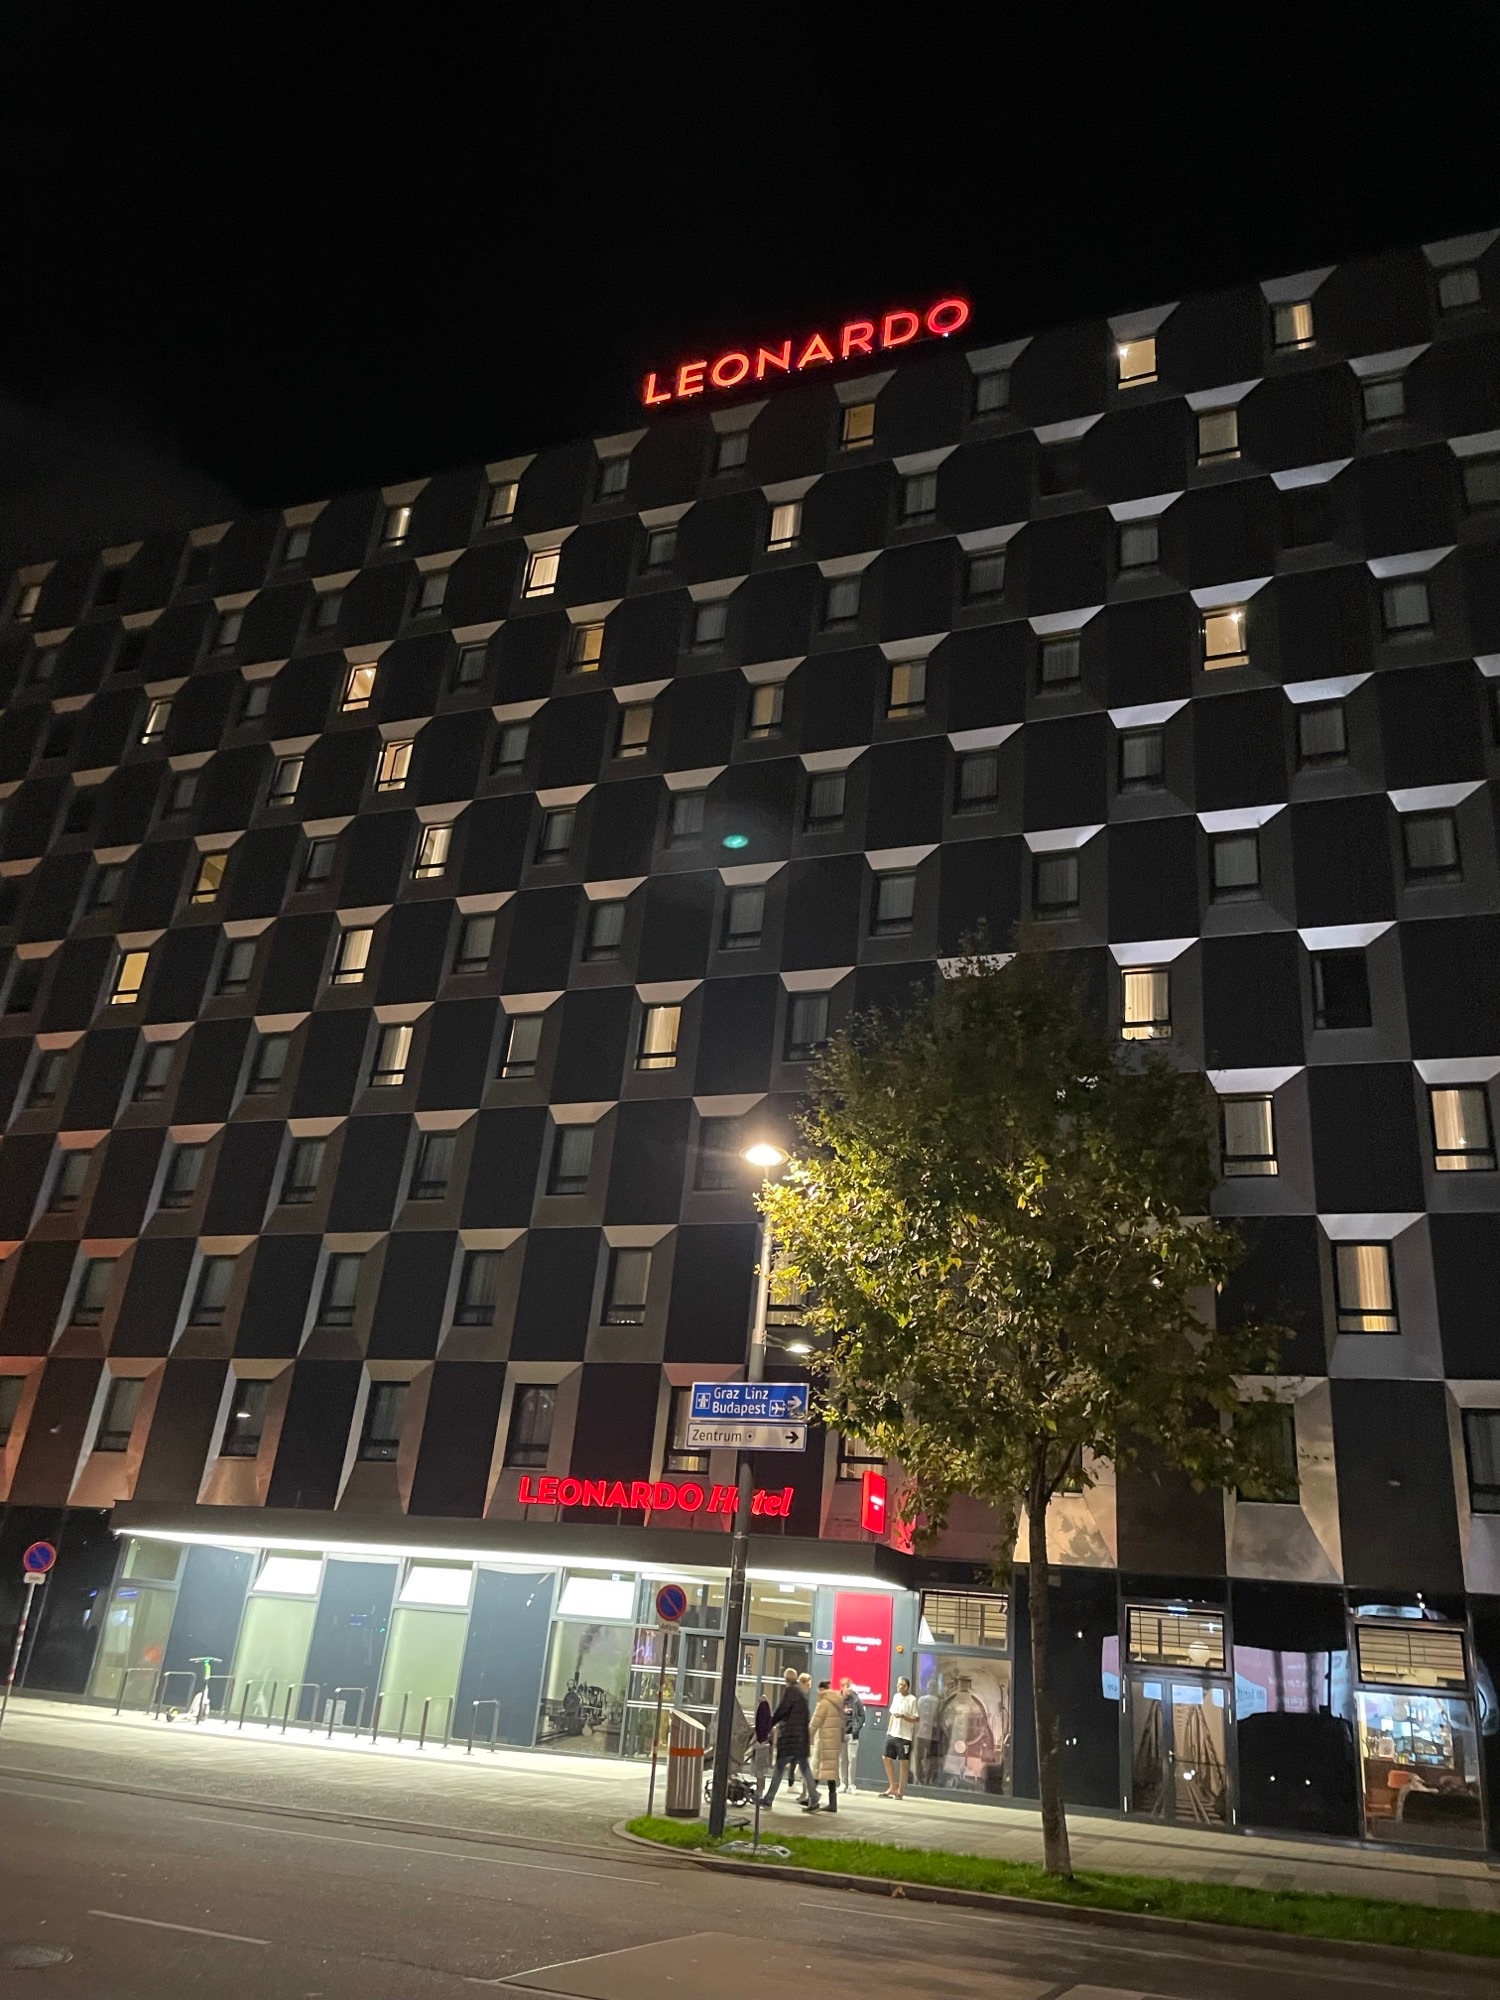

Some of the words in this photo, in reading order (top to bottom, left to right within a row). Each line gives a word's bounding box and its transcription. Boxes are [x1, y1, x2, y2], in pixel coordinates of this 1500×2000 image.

[644, 299, 969, 405] LEONARDO
[714, 1387, 740, 1400] Graz
[745, 1387, 769, 1400] Linz
[712, 1401, 767, 1416] Budapest
[692, 1429, 742, 1442] Zentrum
[518, 1475, 704, 1513] LEONARDO
[706, 1484, 795, 1517] Htel
